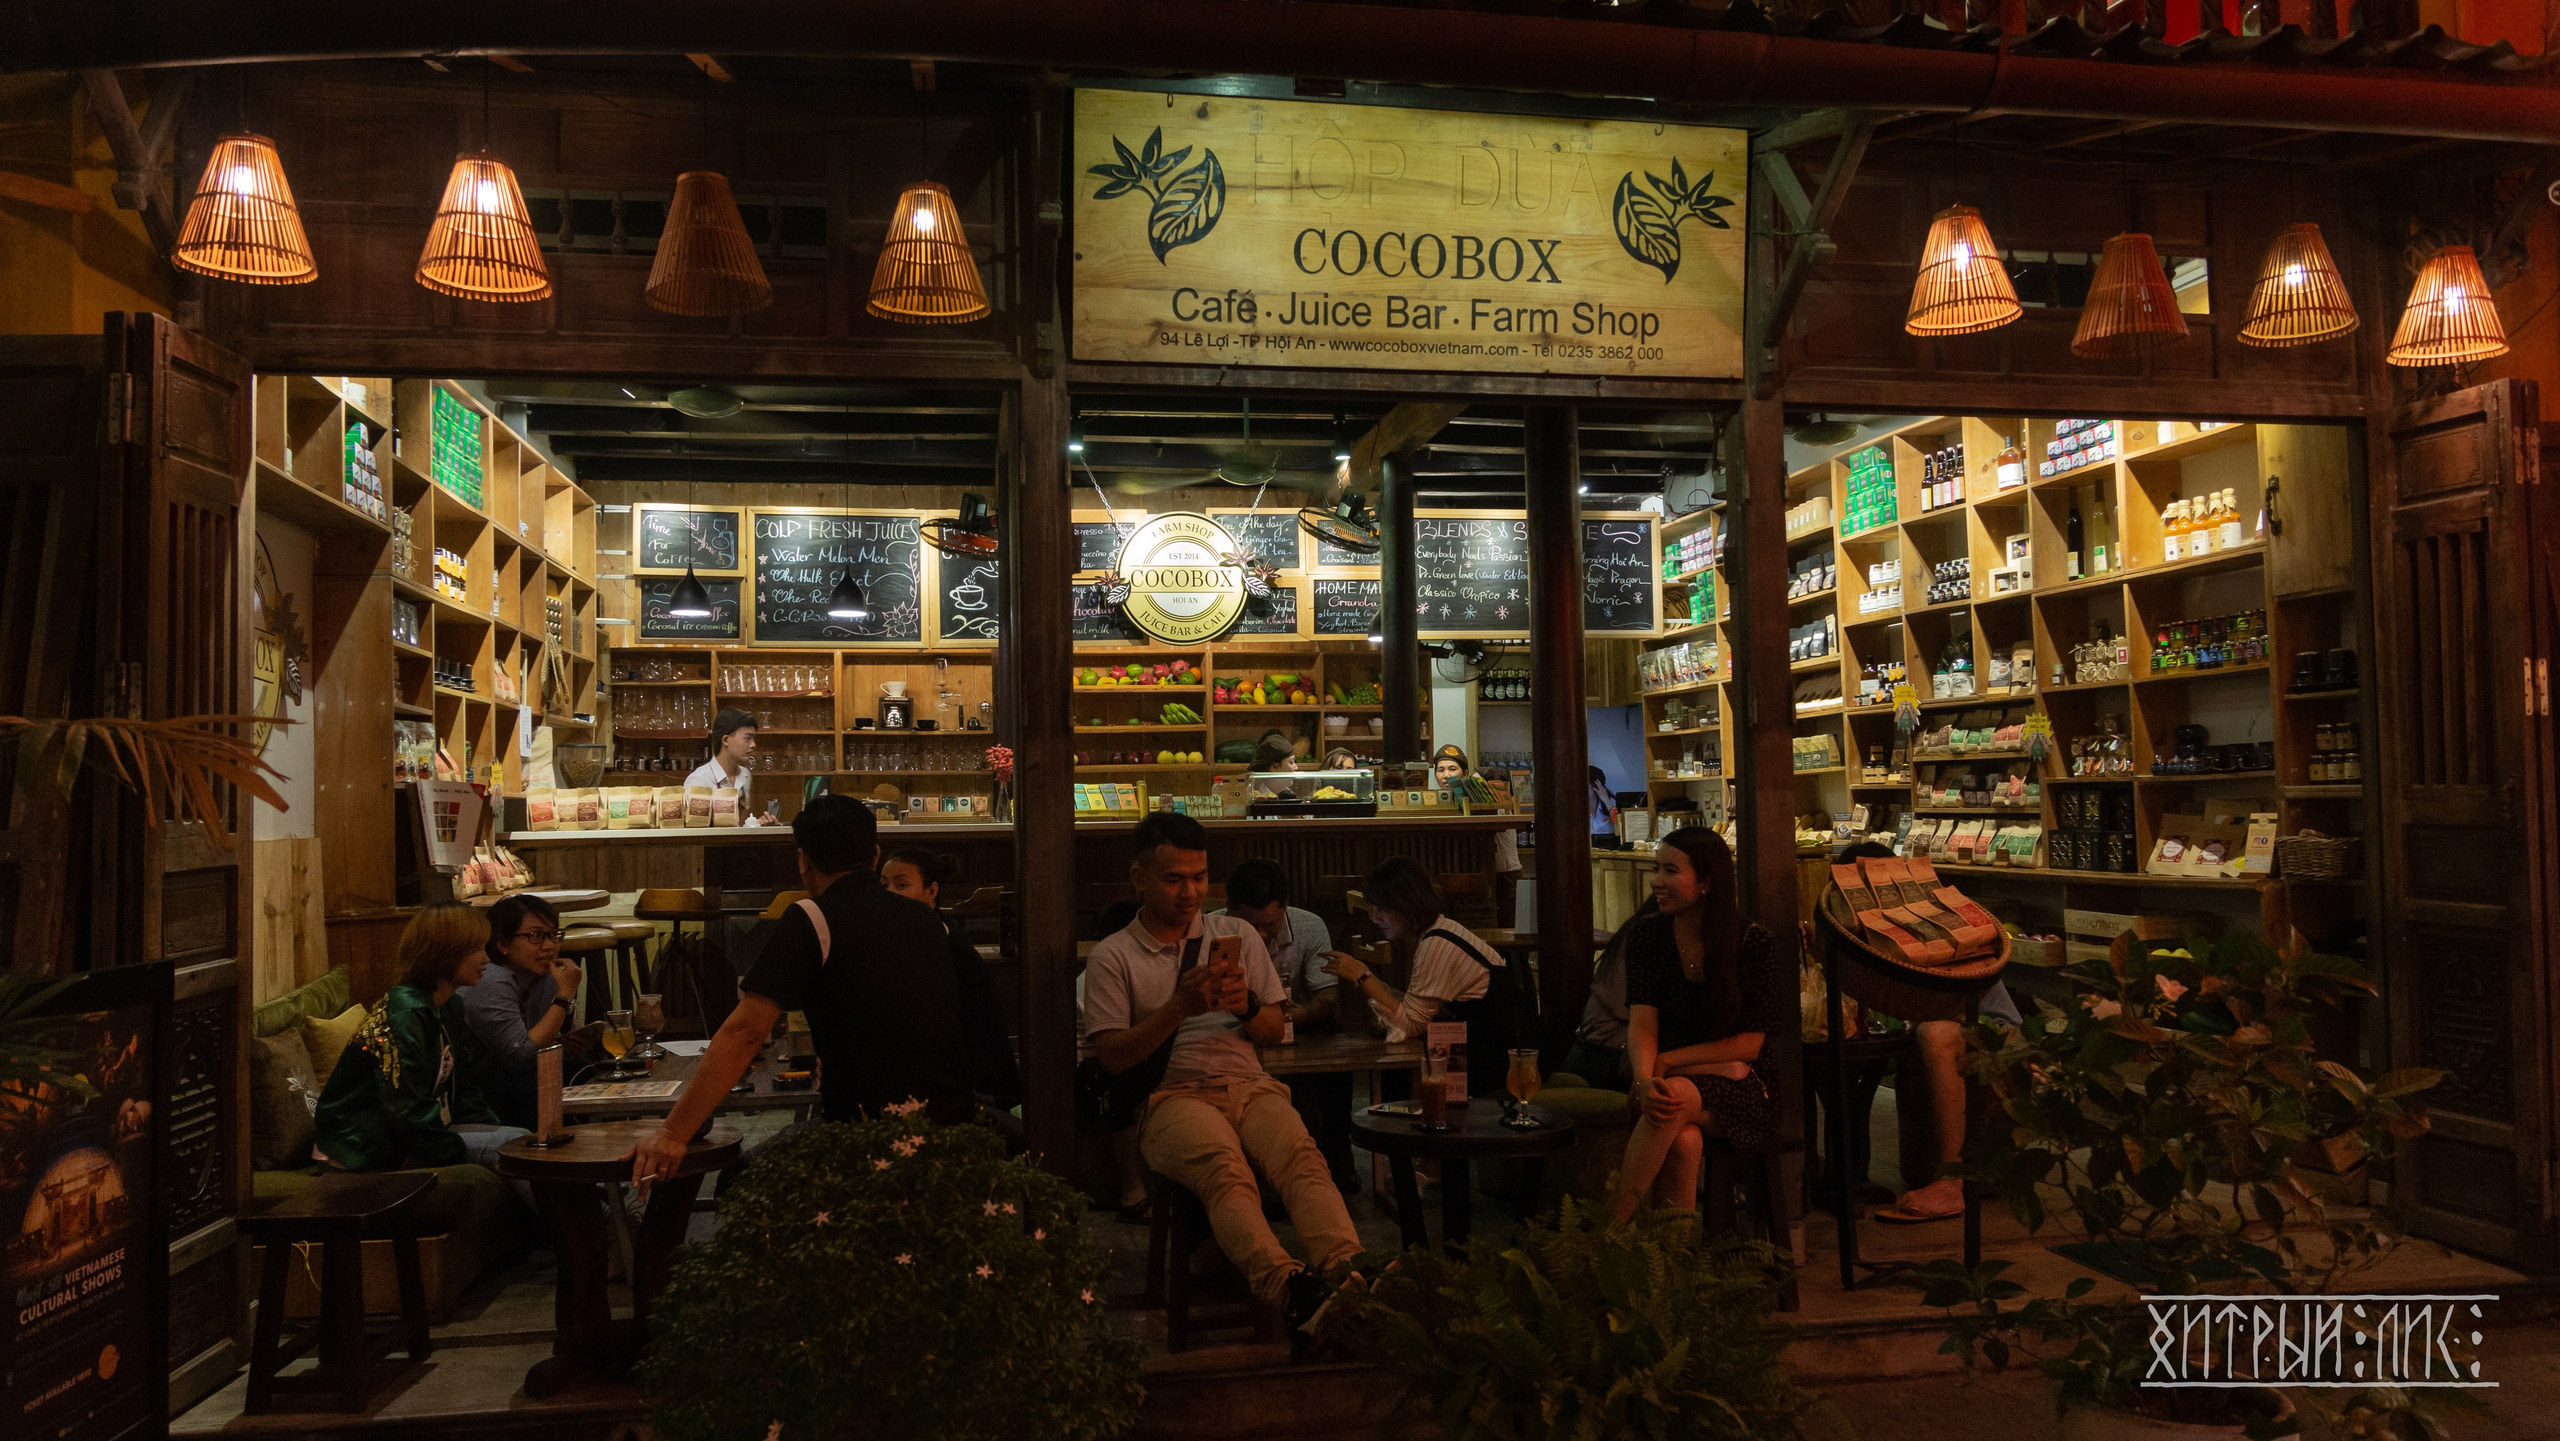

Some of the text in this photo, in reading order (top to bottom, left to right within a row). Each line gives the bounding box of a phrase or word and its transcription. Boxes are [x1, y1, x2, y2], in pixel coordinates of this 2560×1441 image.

[1293, 228, 1562, 284] COCOBOX
[1172, 287, 1660, 344] Café Juice Bar Farm Shop
[1160, 332, 1179, 346] 94
[1184, 332, 1203, 347] Lê
[1207, 334, 1229, 351] Lợi
[1265, 335, 1291, 353] Hội
[1296, 336, 1316, 350] An
[1532, 344, 1554, 357] Tel
[1558, 345, 1593, 358] 0235
[1598, 346, 1633, 360] 3862
[1637, 347, 1664, 360] 000
[643, 514, 671, 535] Time
[756, 518, 801, 539] COLD
[808, 519, 862, 539] FRESH
[1185, 522, 1214, 539] SHOP
[1266, 517, 1294, 537] day
[1414, 519, 1491, 540] BLENDS
[772, 546, 813, 563] Water
[818, 545, 856, 564] Melon
[1169, 552, 1199, 560] EST 2014
[1416, 545, 1457, 566] Everybody
[797, 570, 823, 585] Hulk
[1131, 569, 1234, 588] COCOBOX
[1432, 567, 1457, 580] Green
[1315, 581, 1357, 595] HOME
[1417, 584, 1457, 598] Classico
[1138, 610, 1169, 633] JUICE
[1170, 625, 1191, 636] BAR
[1193, 625, 1203, 635] &
[64, 1247, 126, 1286] VIETNAMESE
[19, 1264, 122, 1326] CULTURAL SHOWS
